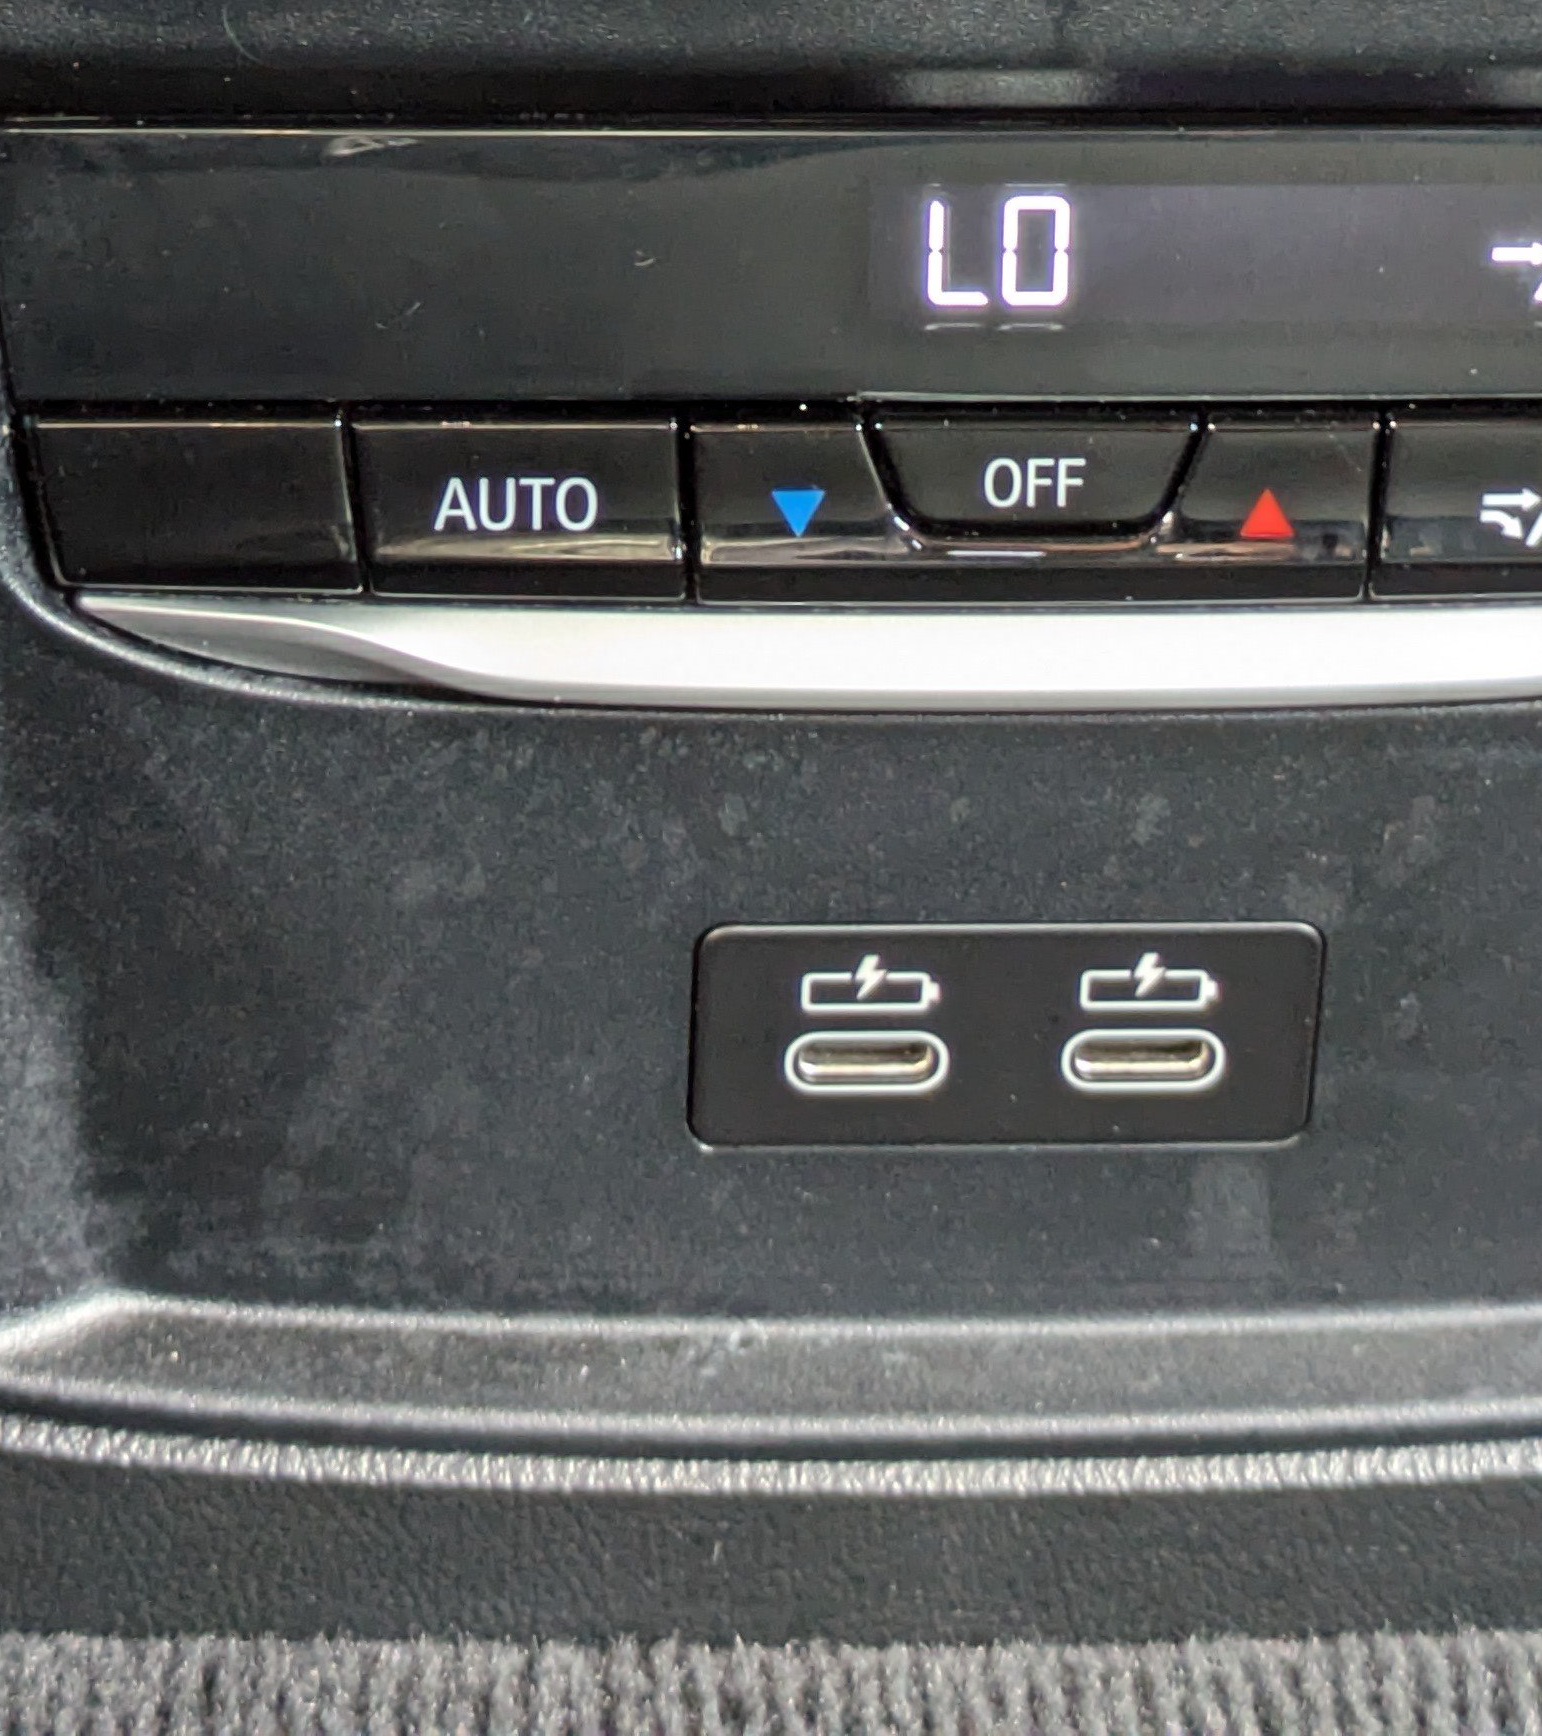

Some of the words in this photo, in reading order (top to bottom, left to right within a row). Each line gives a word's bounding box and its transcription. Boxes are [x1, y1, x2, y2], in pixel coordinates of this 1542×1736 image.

[924, 194, 1074, 307] LO
[432, 476, 599, 533] AUTO
[982, 456, 1088, 510] OFF
